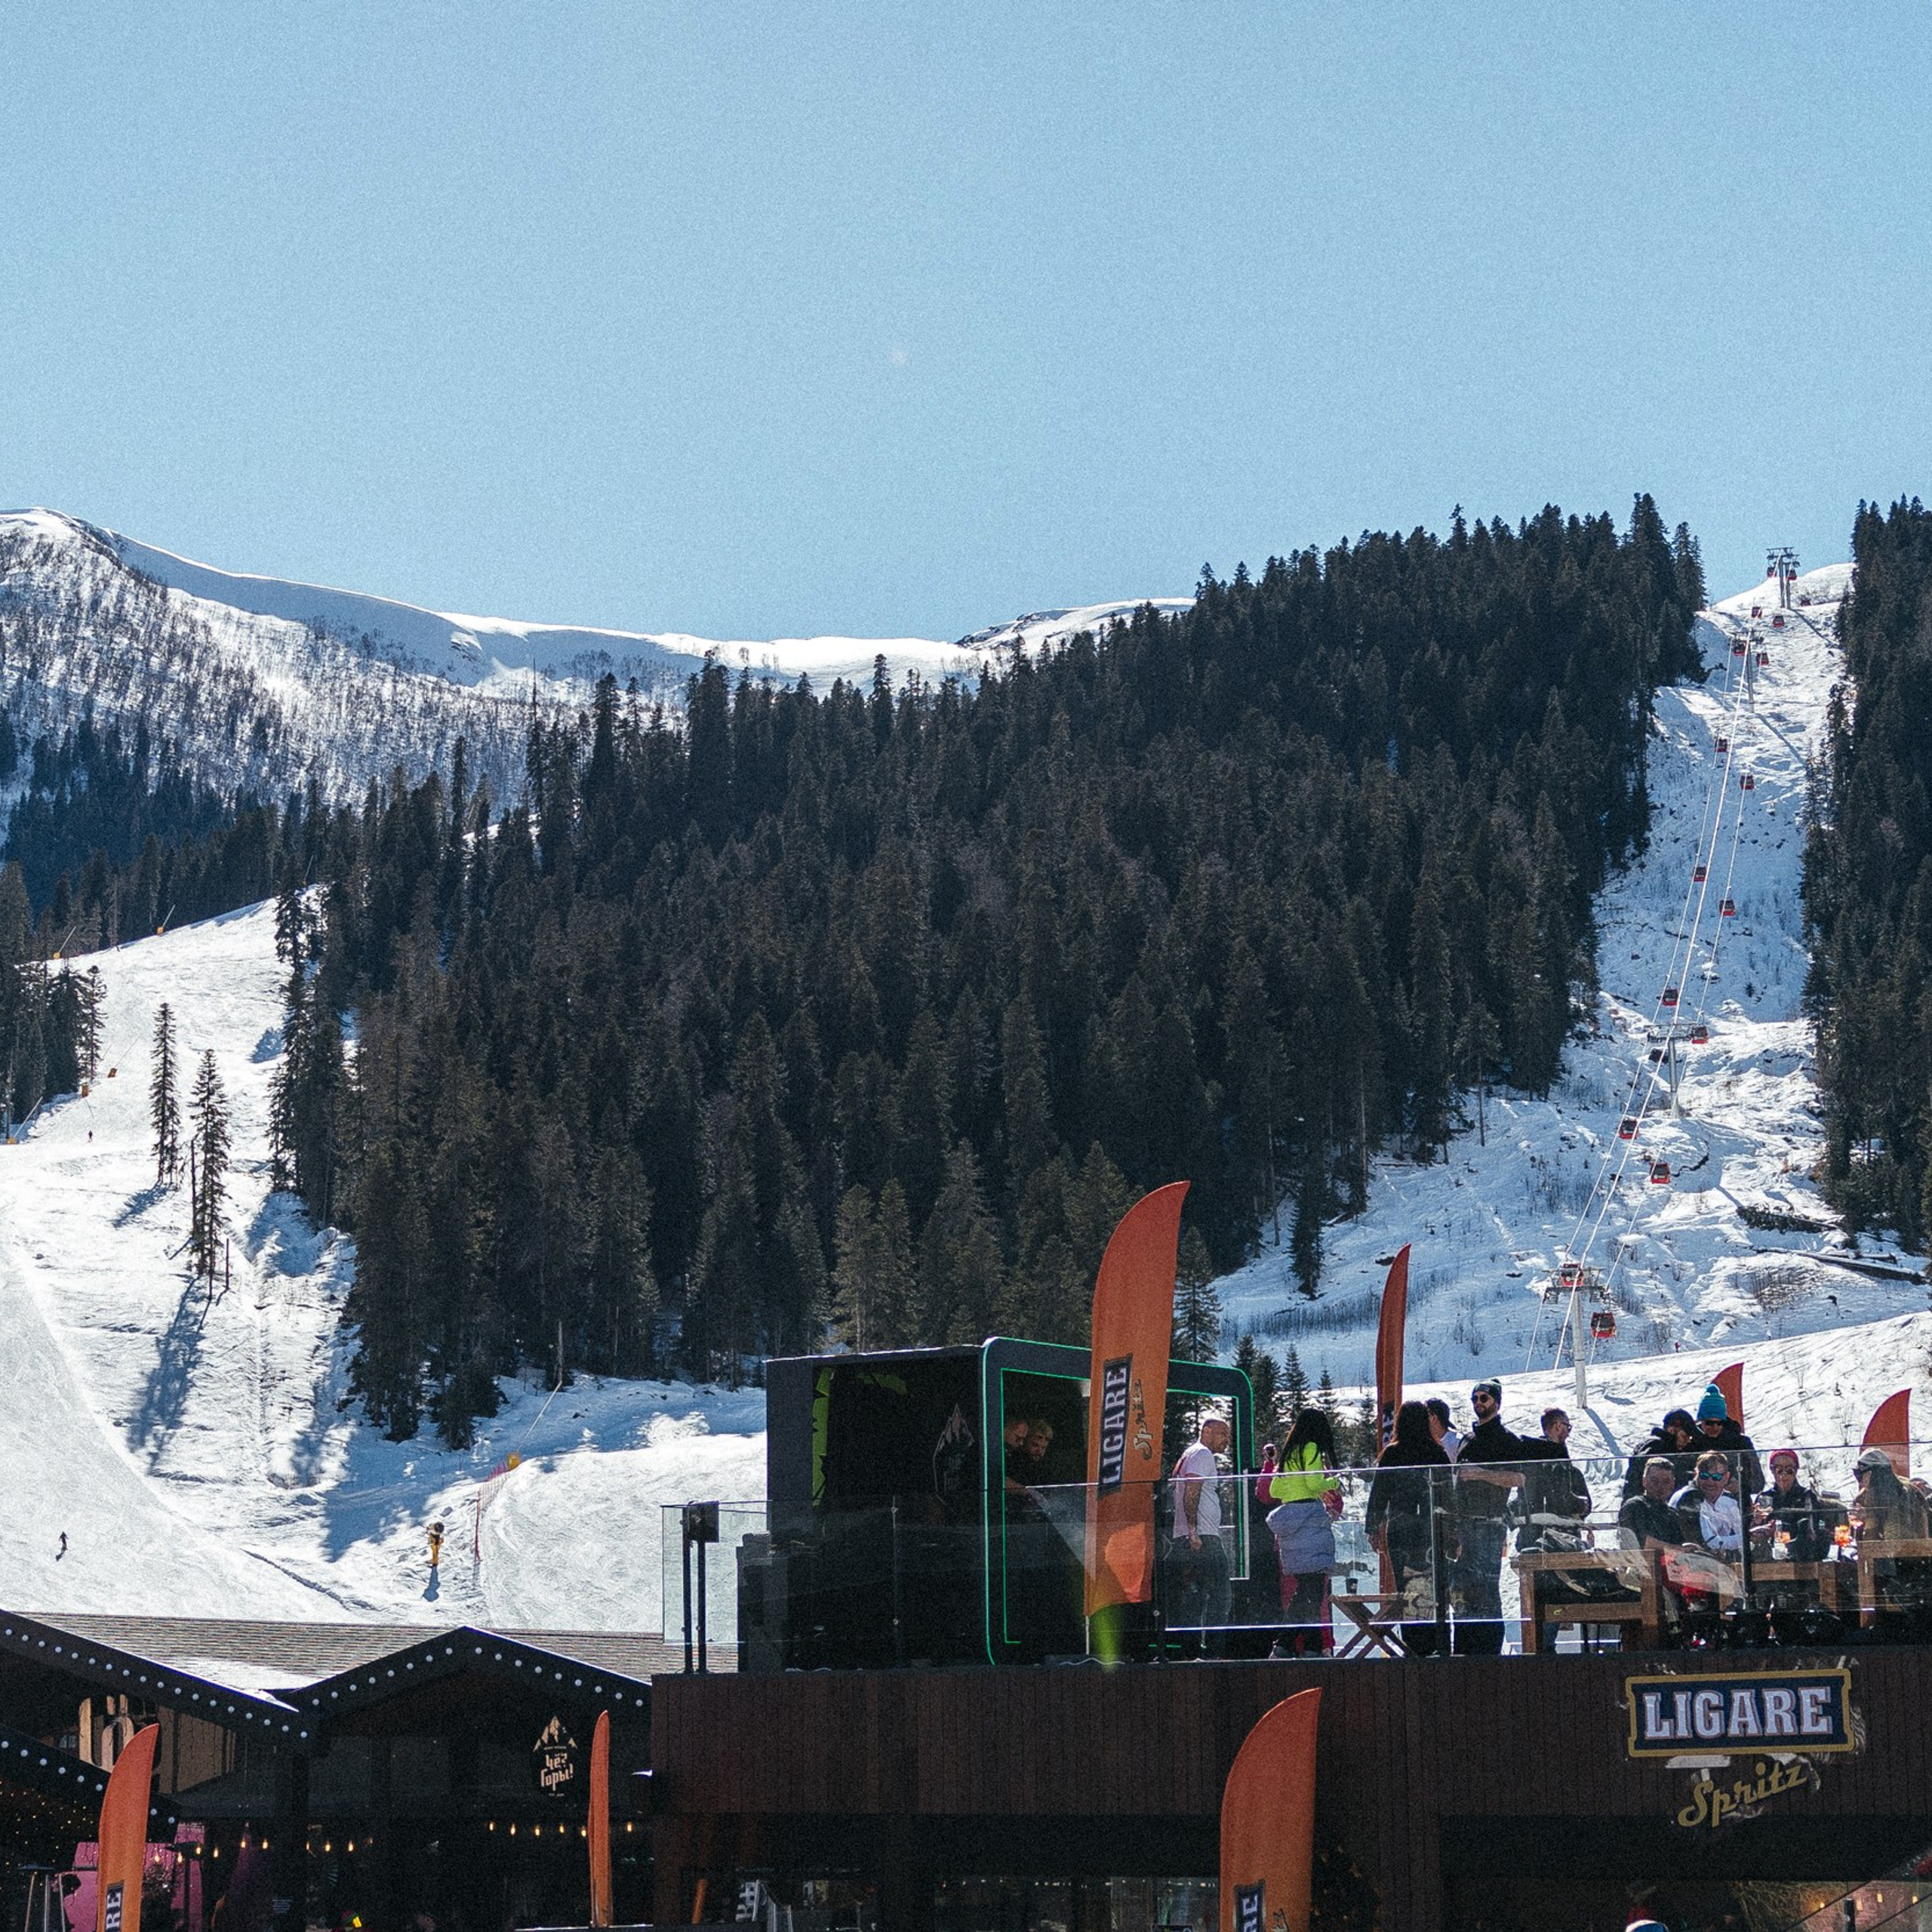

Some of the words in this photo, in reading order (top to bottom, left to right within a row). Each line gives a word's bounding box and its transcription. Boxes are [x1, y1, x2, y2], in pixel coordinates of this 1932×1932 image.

[1103, 1367, 1127, 1484] LIGARE
[1642, 1686, 1833, 1740] LIGARE
[540, 1764, 574, 1791] Горы!
[1677, 1762, 1808, 1827] Spritz
